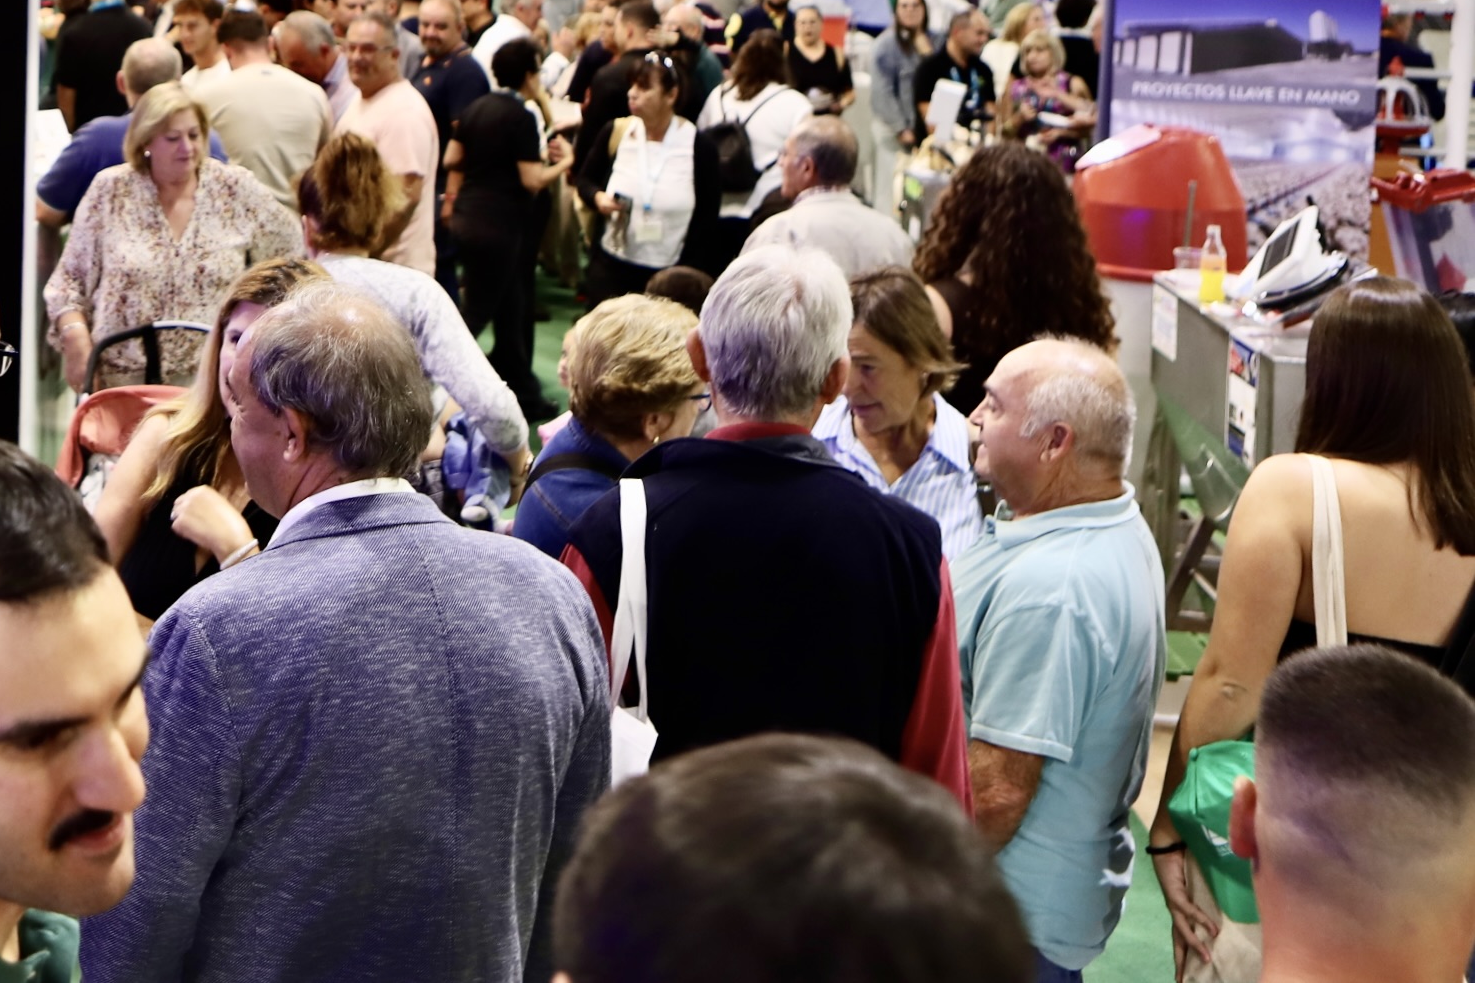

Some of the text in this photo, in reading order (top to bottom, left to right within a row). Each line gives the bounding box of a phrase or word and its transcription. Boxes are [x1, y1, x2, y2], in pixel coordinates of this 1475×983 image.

[1131, 80, 1361, 105] PROYECTOS LLAVE EN MANO
